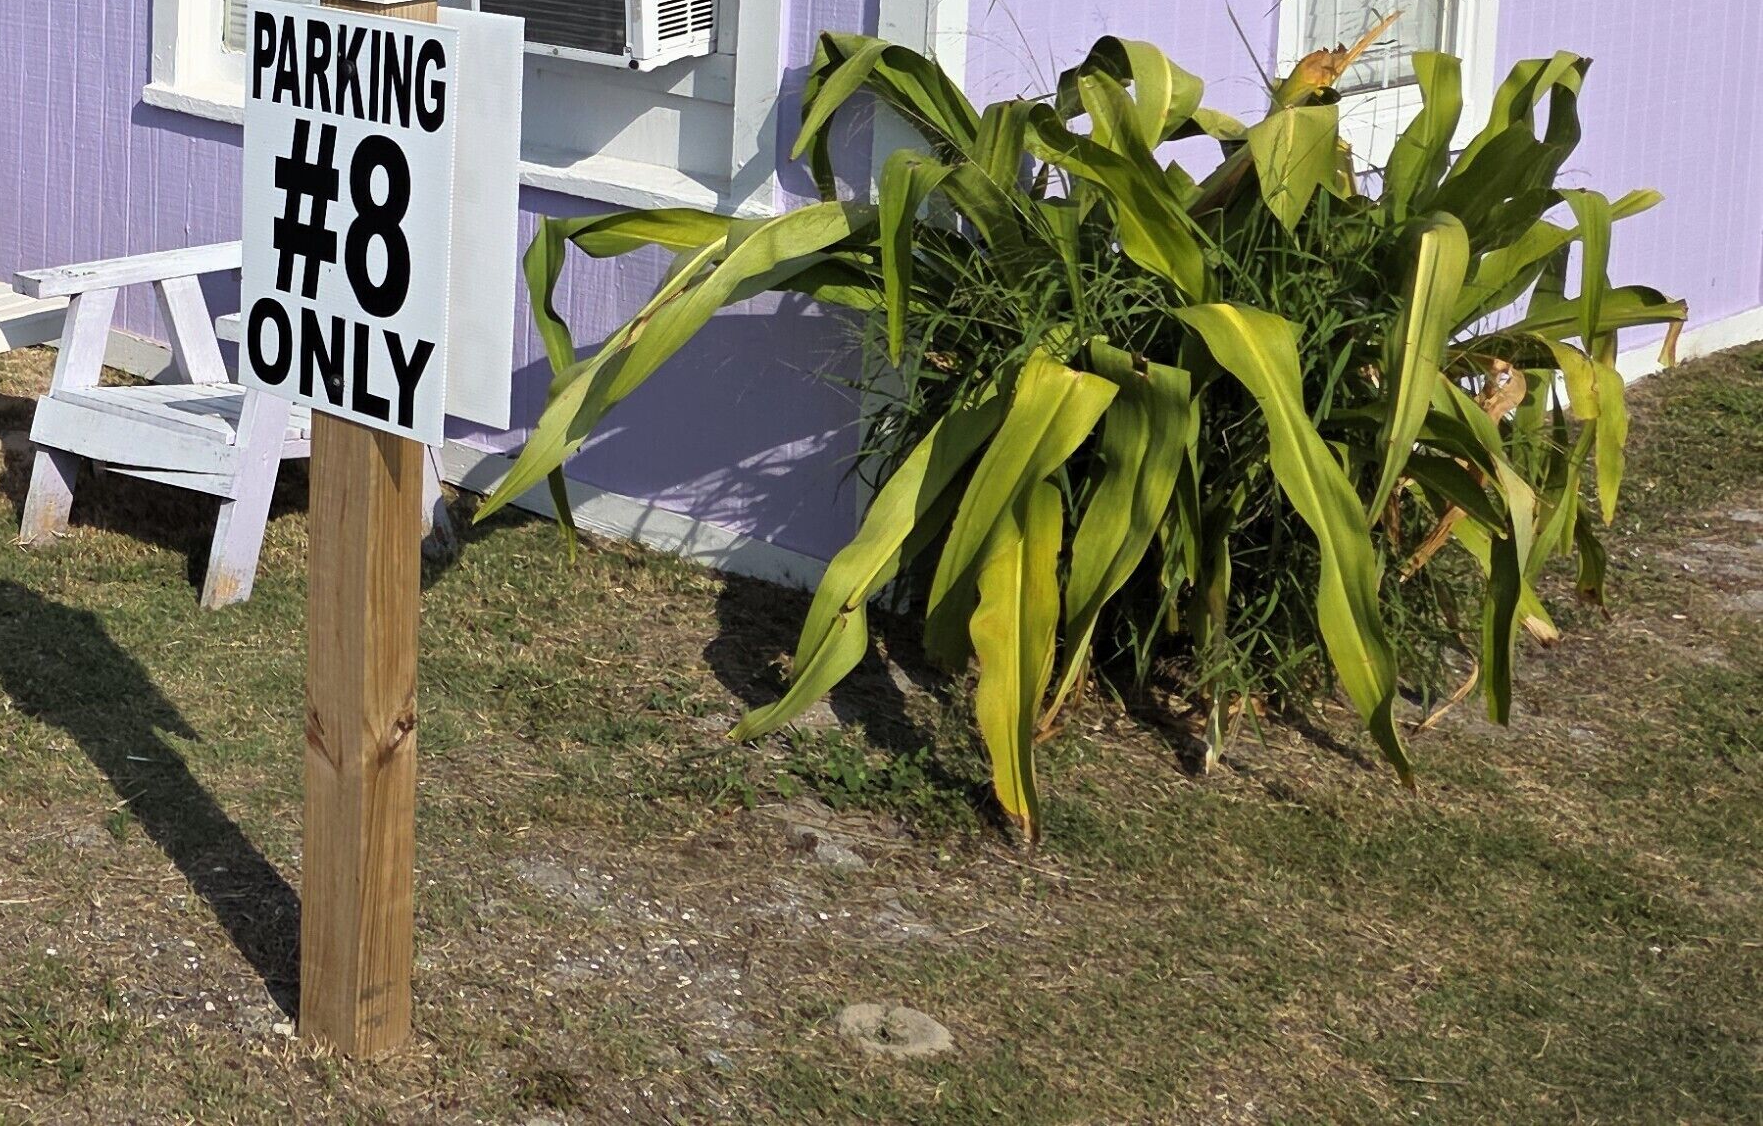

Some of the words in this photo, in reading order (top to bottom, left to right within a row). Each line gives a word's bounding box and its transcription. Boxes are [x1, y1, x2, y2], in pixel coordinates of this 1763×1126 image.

[252, 10, 446, 133] PARKING
[273, 118, 411, 318] #8
[247, 297, 436, 430] ONLY
